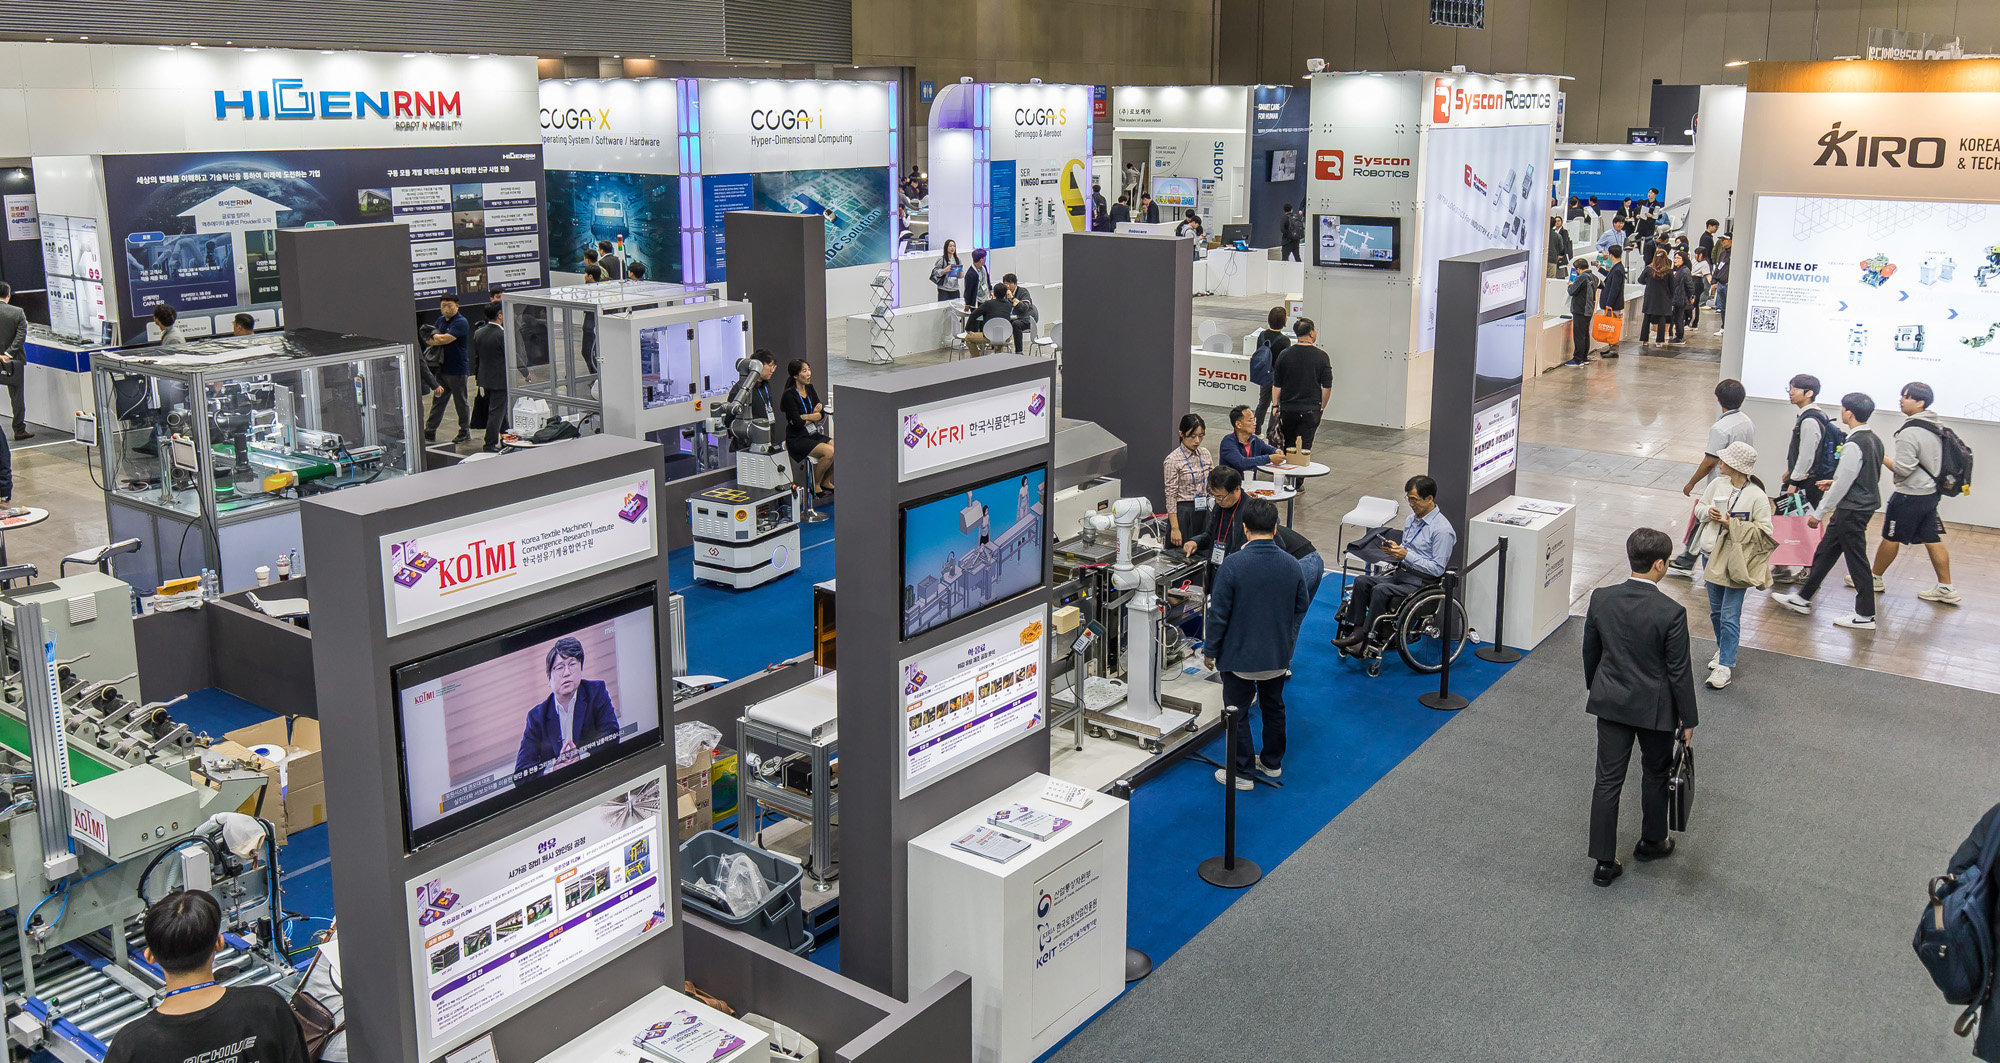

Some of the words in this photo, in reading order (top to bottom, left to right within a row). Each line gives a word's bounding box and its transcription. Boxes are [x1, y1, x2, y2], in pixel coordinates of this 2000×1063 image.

[1455, 88, 1503, 114] Syscon
[1505, 90, 1551, 109] ROBOTICS
[599, 108, 610, 130] X
[751, 109, 813, 130] COGA
[1015, 108, 1057, 126] COGA
[1059, 108, 1066, 125] S
[395, 121, 420, 129] ROBOT
[429, 121, 462, 129] MOBILITY
[568, 135, 590, 146] System
[596, 136, 623, 145] Software
[629, 137, 660, 147] Hardware
[751, 134, 817, 147] Hyper-Dimensional
[818, 133, 853, 144] Computing
[1014, 129, 1038, 139] Servinggo
[1044, 130, 1062, 138] Aerobot
[1813, 121, 1946, 168] KIRO
[1959, 138, 2000, 152] KOREA
[1213, 141, 1224, 182] SILBOT
[1354, 155, 1410, 167] Syscon
[1957, 157, 1966, 170] &
[136, 176, 158, 185] 세상의
[159, 175, 180, 184] 변화를
[181, 174, 208, 183] 이해하고
[210, 172, 241, 182] 기술혁신을
[243, 171, 262, 180] 통하여
[263, 171, 282, 179] 미래에
[283, 170, 307, 179] 도전하는
[308, 169, 321, 178] 기업
[1020, 168, 1030, 177] SER
[1353, 168, 1410, 178] ROBOTICS
[1020, 178, 1039, 186] VINGGO
[839, 207, 882, 244] Solution
[1754, 260, 1802, 271] TIMELINE
[1766, 272, 1830, 283] INNOVATION
[1198, 367, 1247, 381] Syscon
[1198, 379, 1247, 392] ROBOTICS
[927, 424, 963, 449] KFRI
[969, 410, 1026, 437] 한국식품연구원
[522, 538, 562, 555] Convergence
[563, 529, 591, 543] Research
[591, 523, 615, 535] Institute
[438, 539, 517, 589] KOTMI
[521, 535, 540, 546] Korea
[540, 528, 562, 540] Textile
[562, 521, 593, 537] Machinery
[522, 538, 594, 567] 한국섬유기계융합연구원
[73, 808, 105, 842] KOTMI
